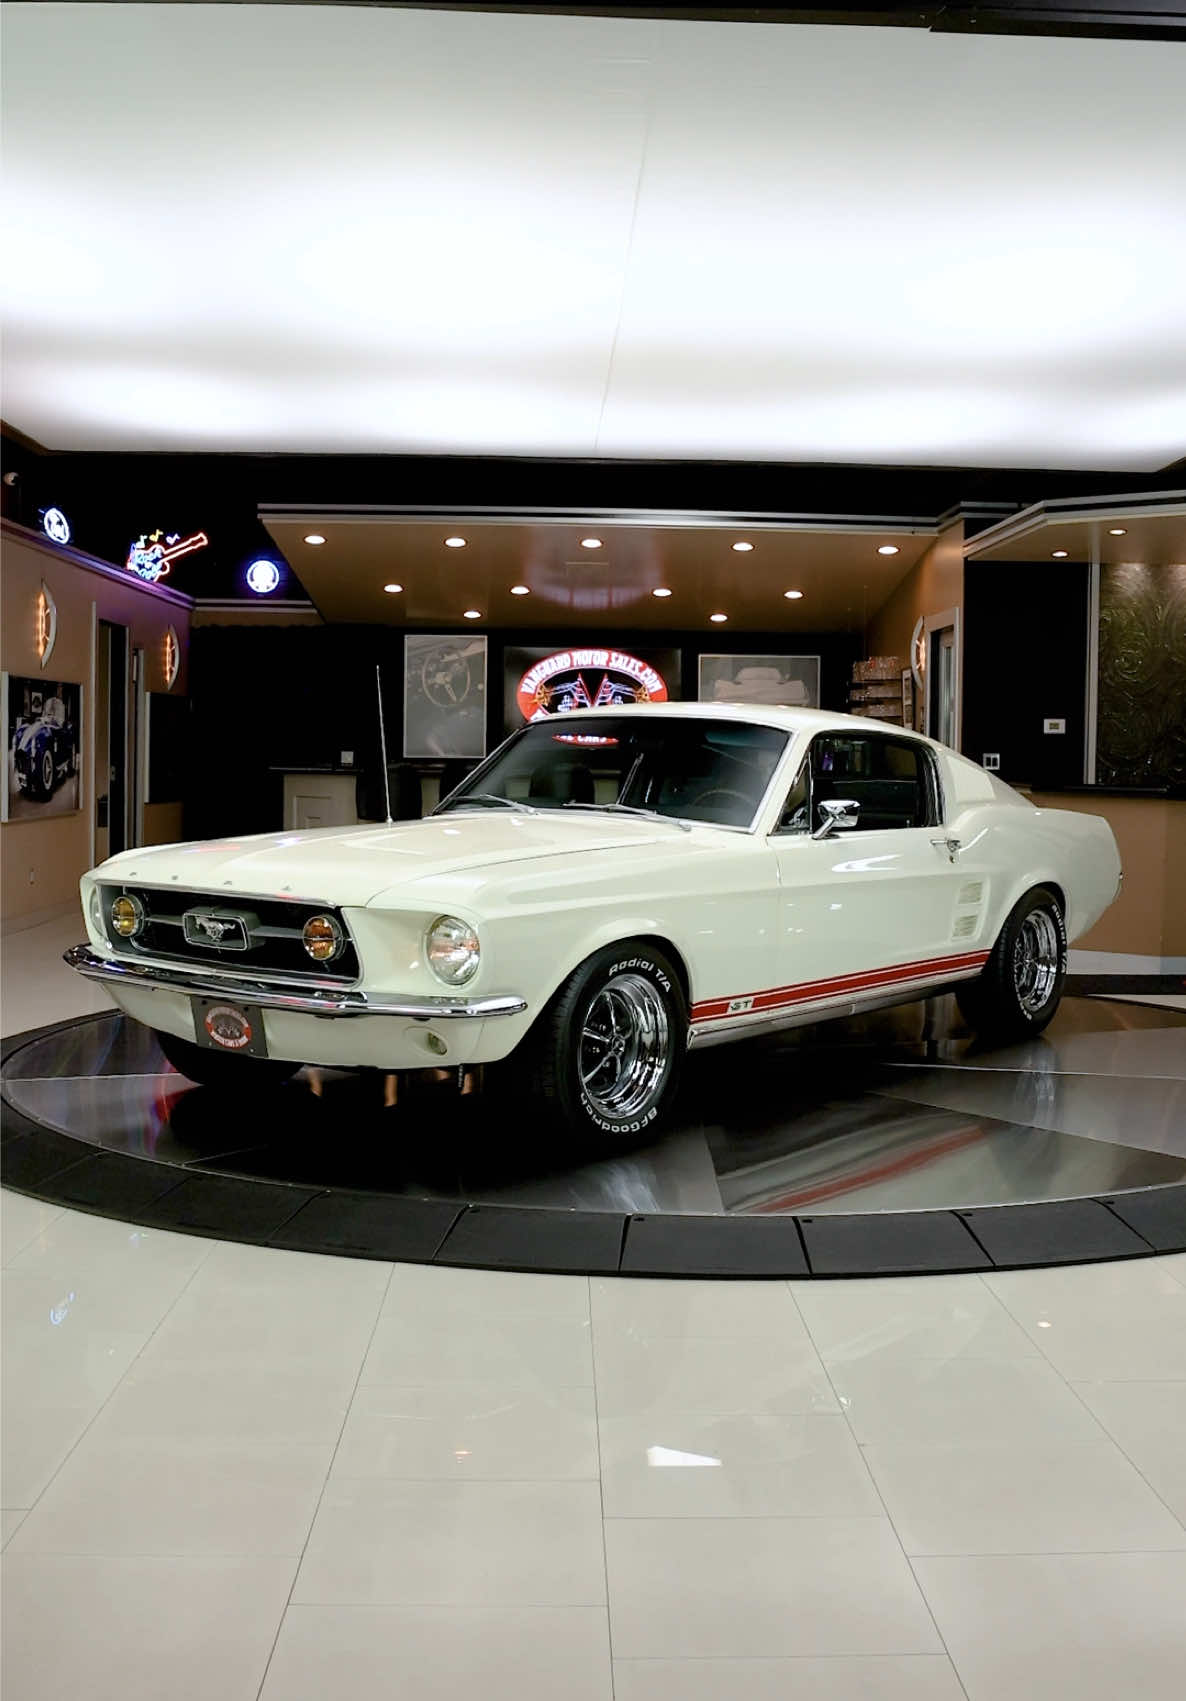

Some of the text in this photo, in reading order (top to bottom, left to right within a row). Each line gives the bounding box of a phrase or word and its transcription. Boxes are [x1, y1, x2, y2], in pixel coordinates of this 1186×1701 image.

[520, 649, 664, 694] VANGUARD MOTOR SALES.COM
[608, 957, 673, 993] Radial T/A
[730, 999, 752, 1011] GT
[580, 1091, 659, 1134] BFGoodrich
